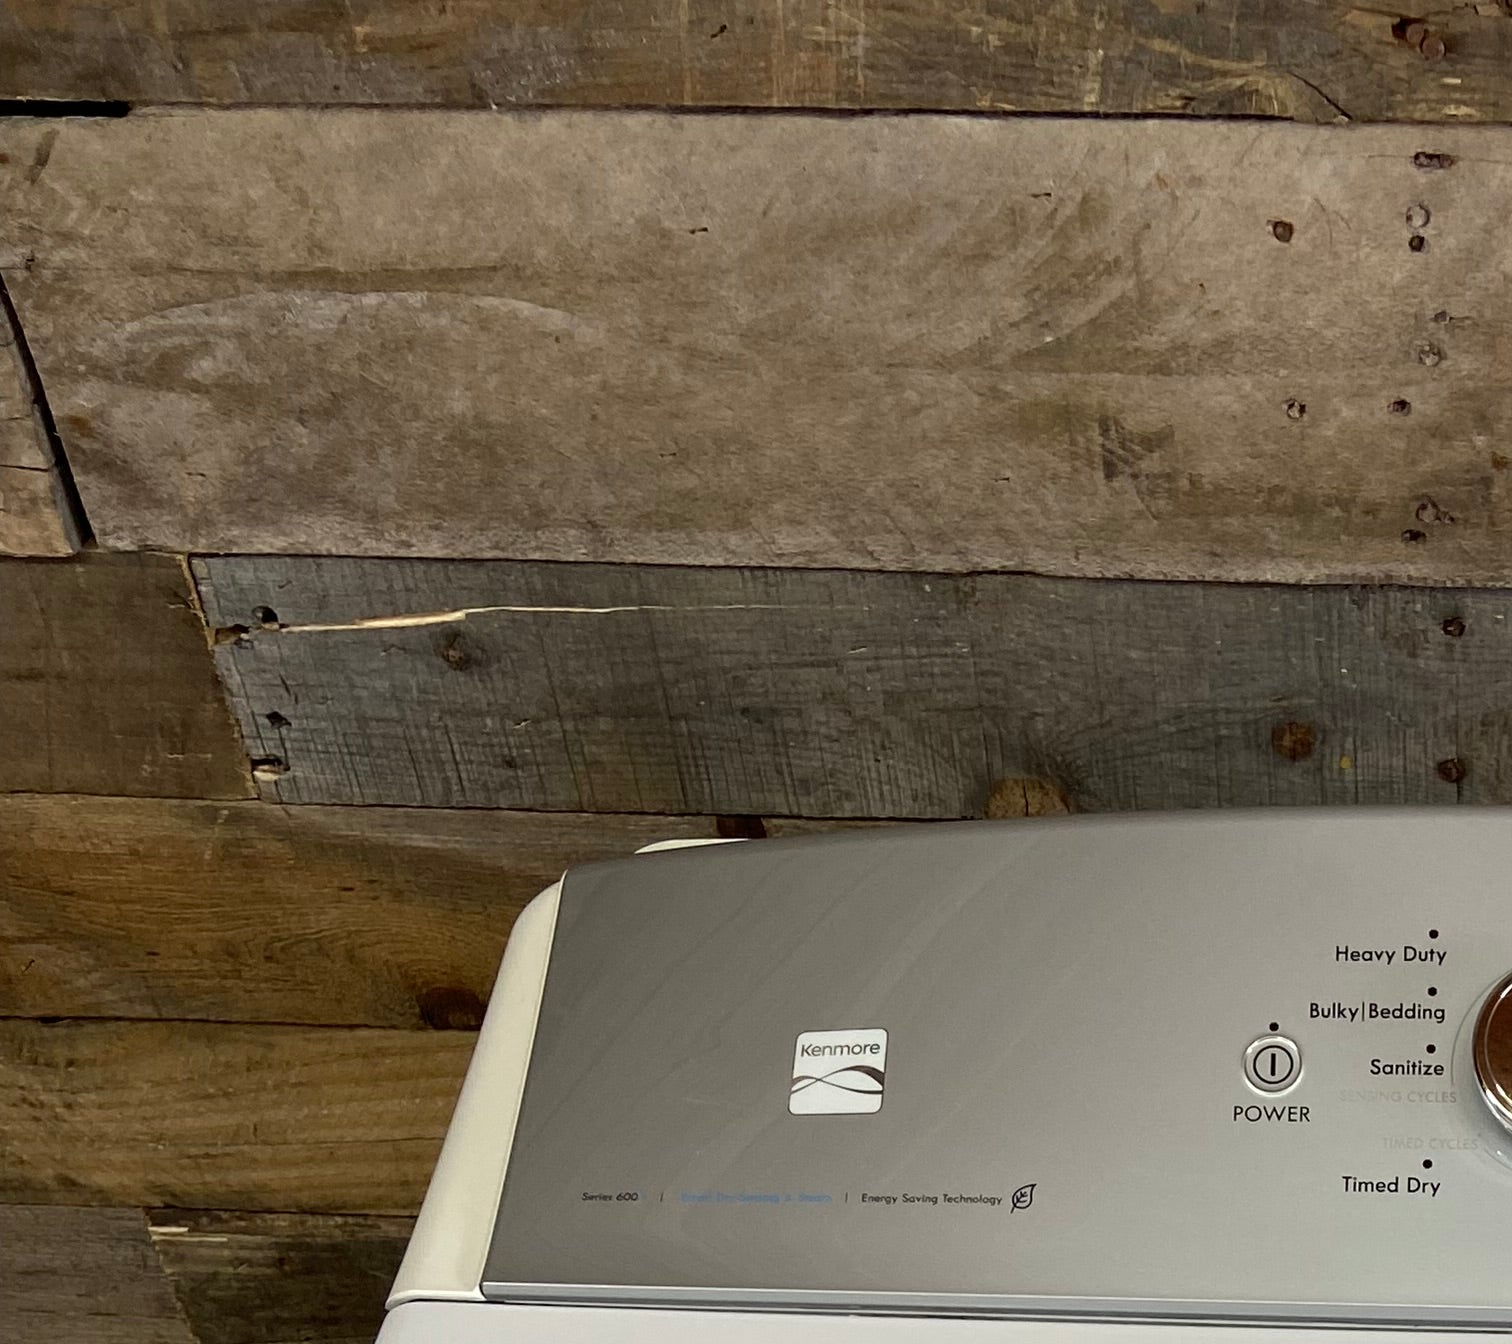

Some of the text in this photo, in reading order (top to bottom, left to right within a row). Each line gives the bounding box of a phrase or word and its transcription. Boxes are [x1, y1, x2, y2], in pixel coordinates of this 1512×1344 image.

[1335, 946, 1447, 966] Heavy Duty
[800, 1039, 881, 1059] Kenmore
[1369, 1058, 1445, 1077] Sanitize
[1407, 1091, 1457, 1104] CYCLES
[1233, 1106, 1311, 1123] POWER
[1342, 1176, 1441, 1198] Timed Dry
[581, 1192, 639, 1202] Series 600
[861, 1193, 1003, 1206] Energy Saving Technology
